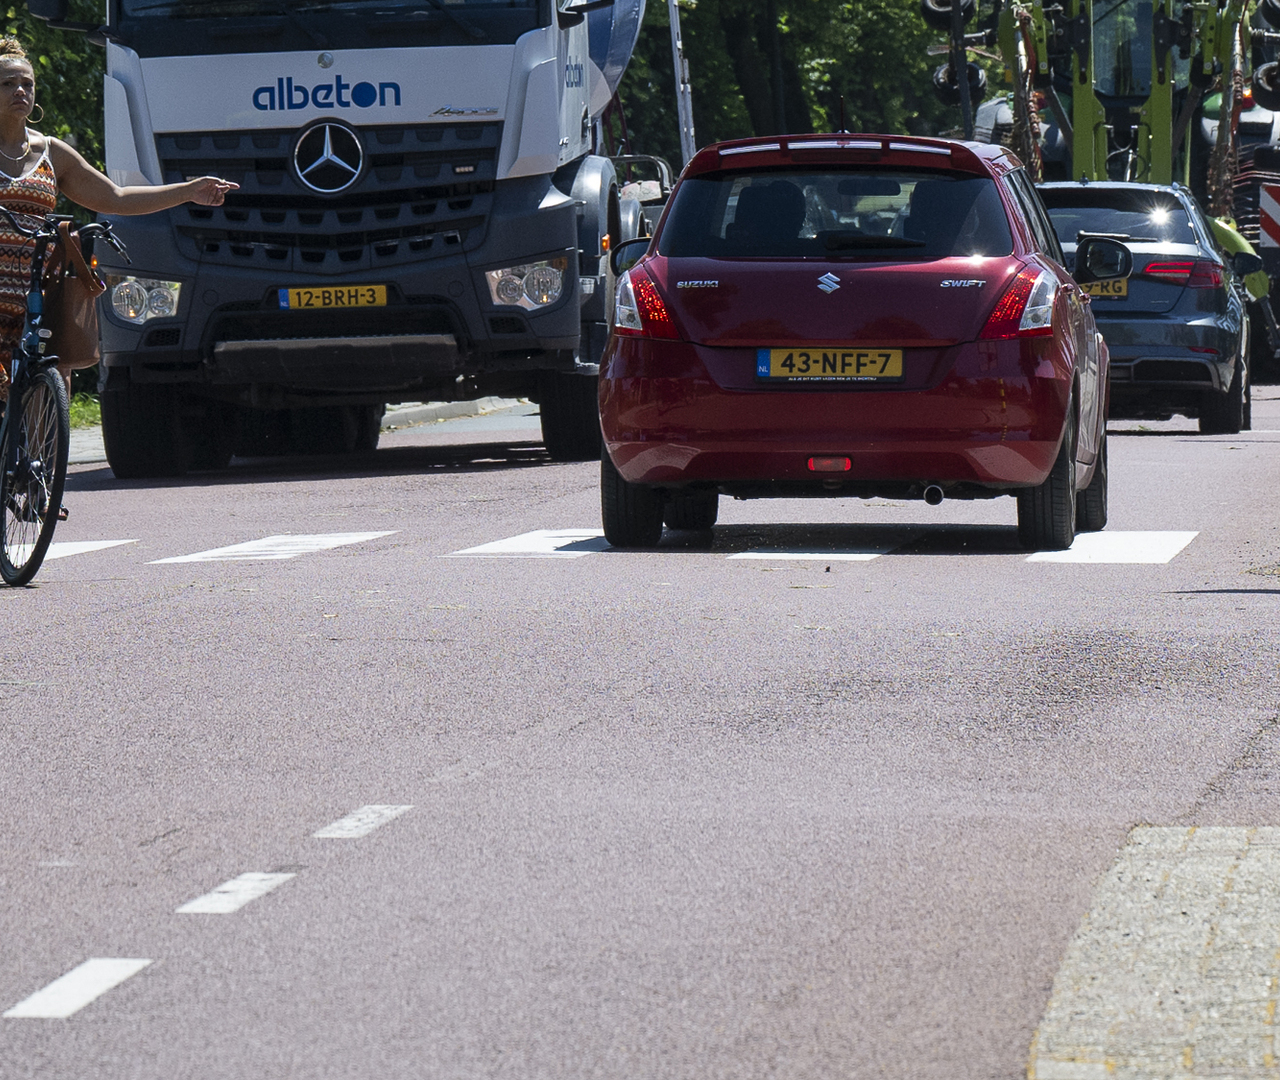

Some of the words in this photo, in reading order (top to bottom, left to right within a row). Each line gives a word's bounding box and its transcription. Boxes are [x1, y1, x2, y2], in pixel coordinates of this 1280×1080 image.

[252, 74, 402, 111] albeton
[676, 280, 719, 289] SUZUKI
[939, 279, 987, 288] SWIFT
[295, 288, 377, 307] 12-BRH-3
[780, 352, 892, 374] 43-NFF-7
